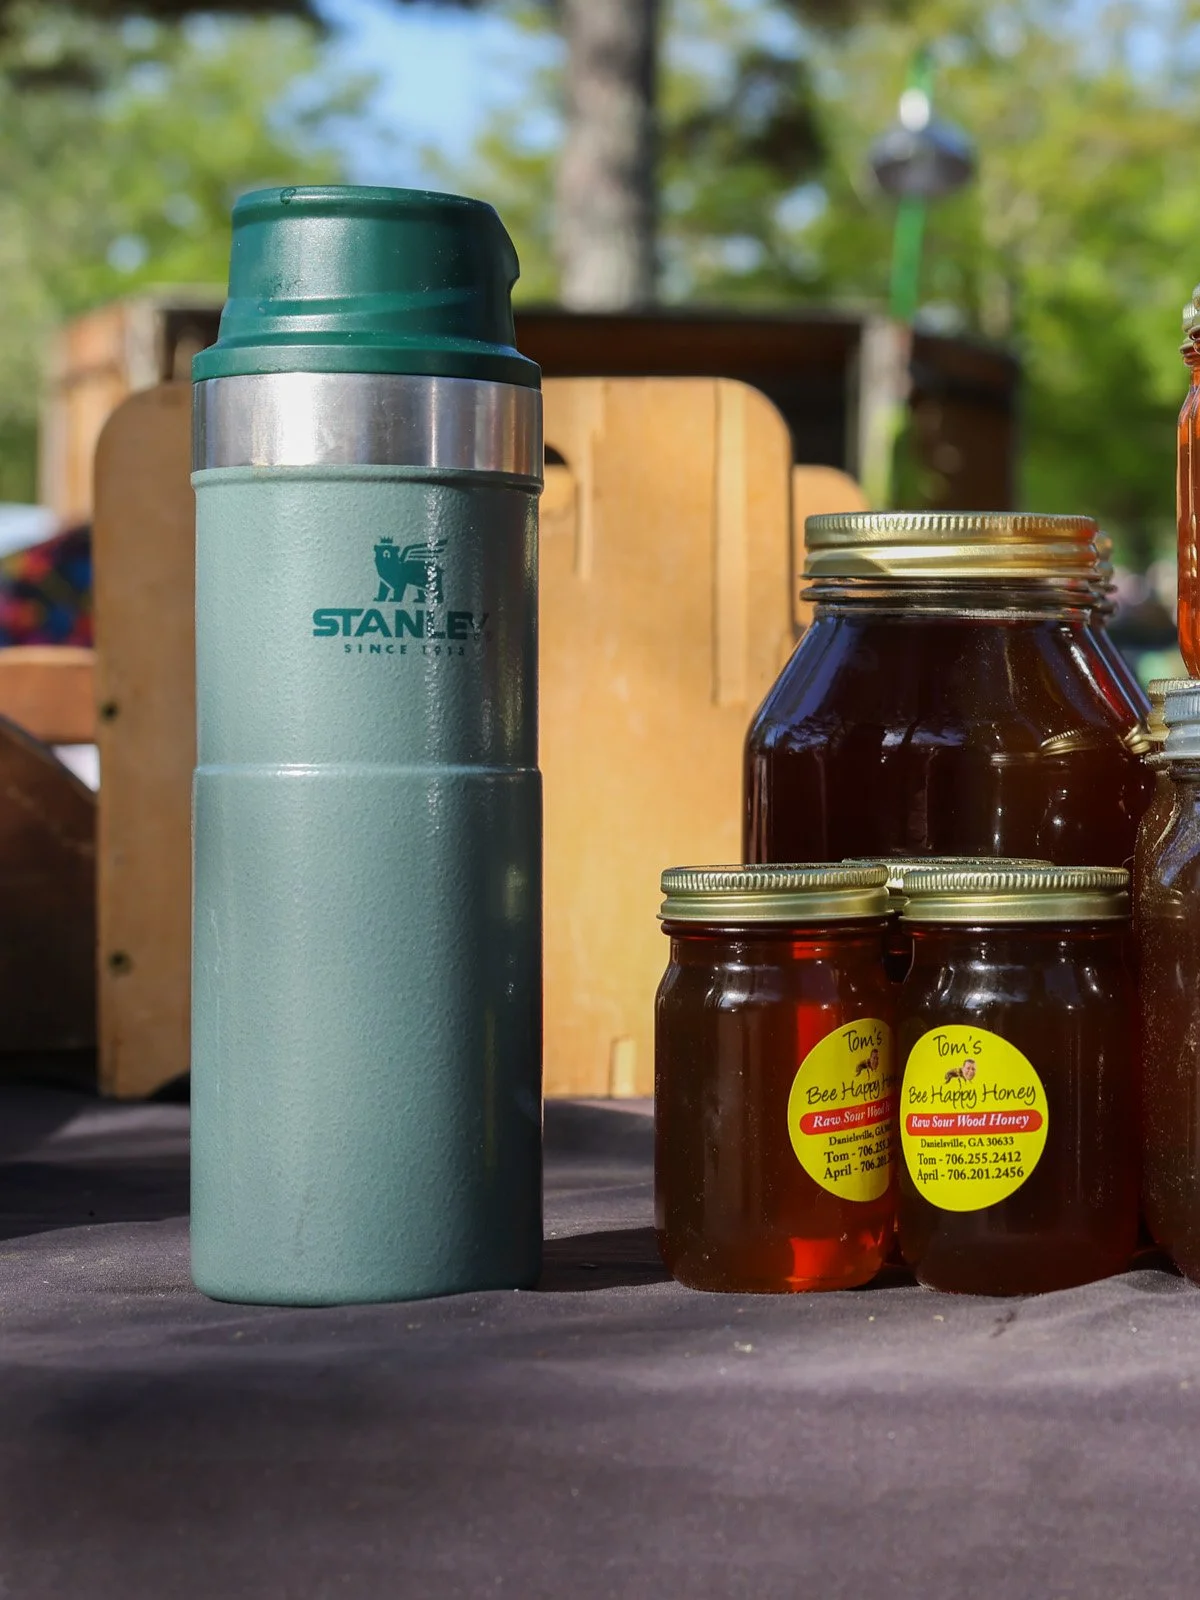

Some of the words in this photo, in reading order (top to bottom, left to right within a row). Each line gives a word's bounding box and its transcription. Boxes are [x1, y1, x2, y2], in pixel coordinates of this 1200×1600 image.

[312, 608, 490, 640] STANLEY
[345, 643, 407, 655] SINCE
[842, 1027, 882, 1052] Tom's
[933, 1034, 982, 1057] Tom's
[806, 1086, 838, 1105] Bee
[841, 1080, 880, 1101] Happy
[909, 1086, 927, 1104] Bee
[931, 1085, 978, 1109] Happy
[982, 1083, 1036, 1106] Honey
[813, 1115, 841, 1128] Raw
[843, 1110, 865, 1123] Sour
[911, 1116, 931, 1128] Raw
[932, 1116, 955, 1128] Sour
[957, 1114, 986, 1127] Wood
[989, 1113, 1029, 1129] Honey
[829, 1130, 875, 1146] Danielsville,
[920, 1138, 966, 1149] Danielsville,
[967, 1137, 984, 1147] GA
[986, 1136, 1014, 1147] 30633
[824, 1151, 849, 1163] Tom
[917, 1152, 936, 1165] Tom
[945, 1151, 1022, 1165] 706.255.2412
[823, 1164, 851, 1181] April
[917, 1168, 938, 1184] April
[948, 1166, 1024, 1181] 706.201.2456
